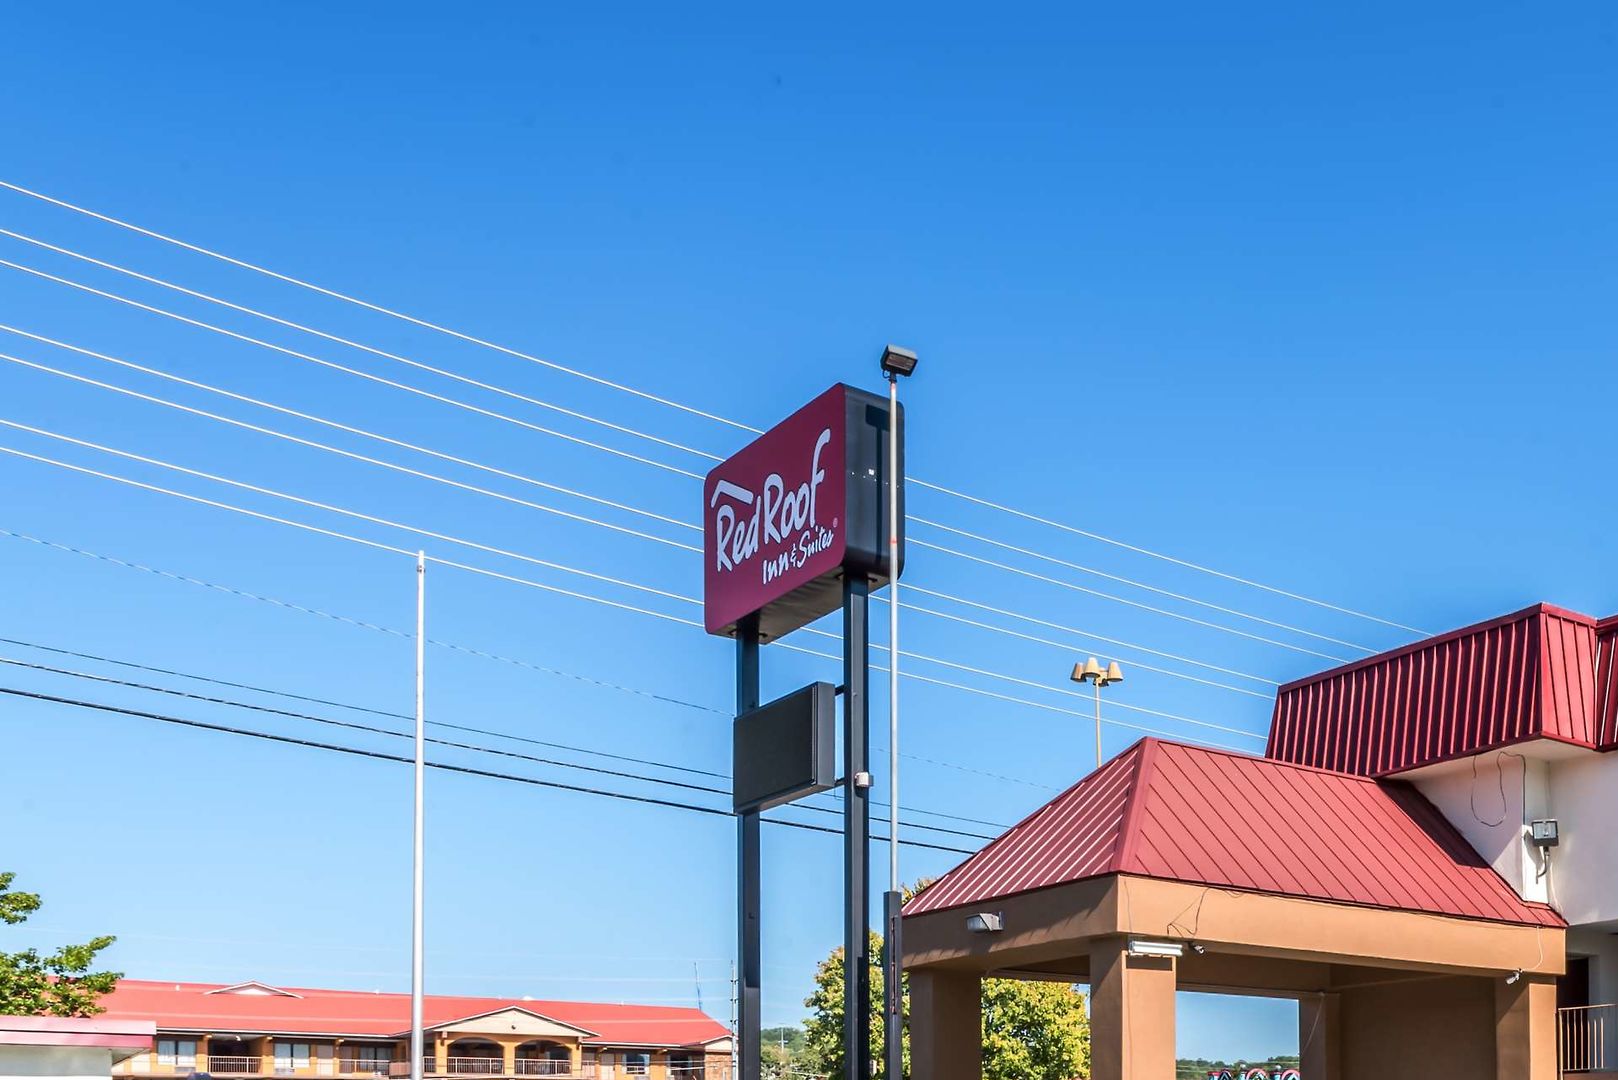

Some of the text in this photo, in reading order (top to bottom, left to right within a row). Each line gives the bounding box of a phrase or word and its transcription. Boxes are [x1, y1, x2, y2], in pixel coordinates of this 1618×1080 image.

[716, 428, 831, 572] Red Roof
[763, 552, 789, 585] Inn
